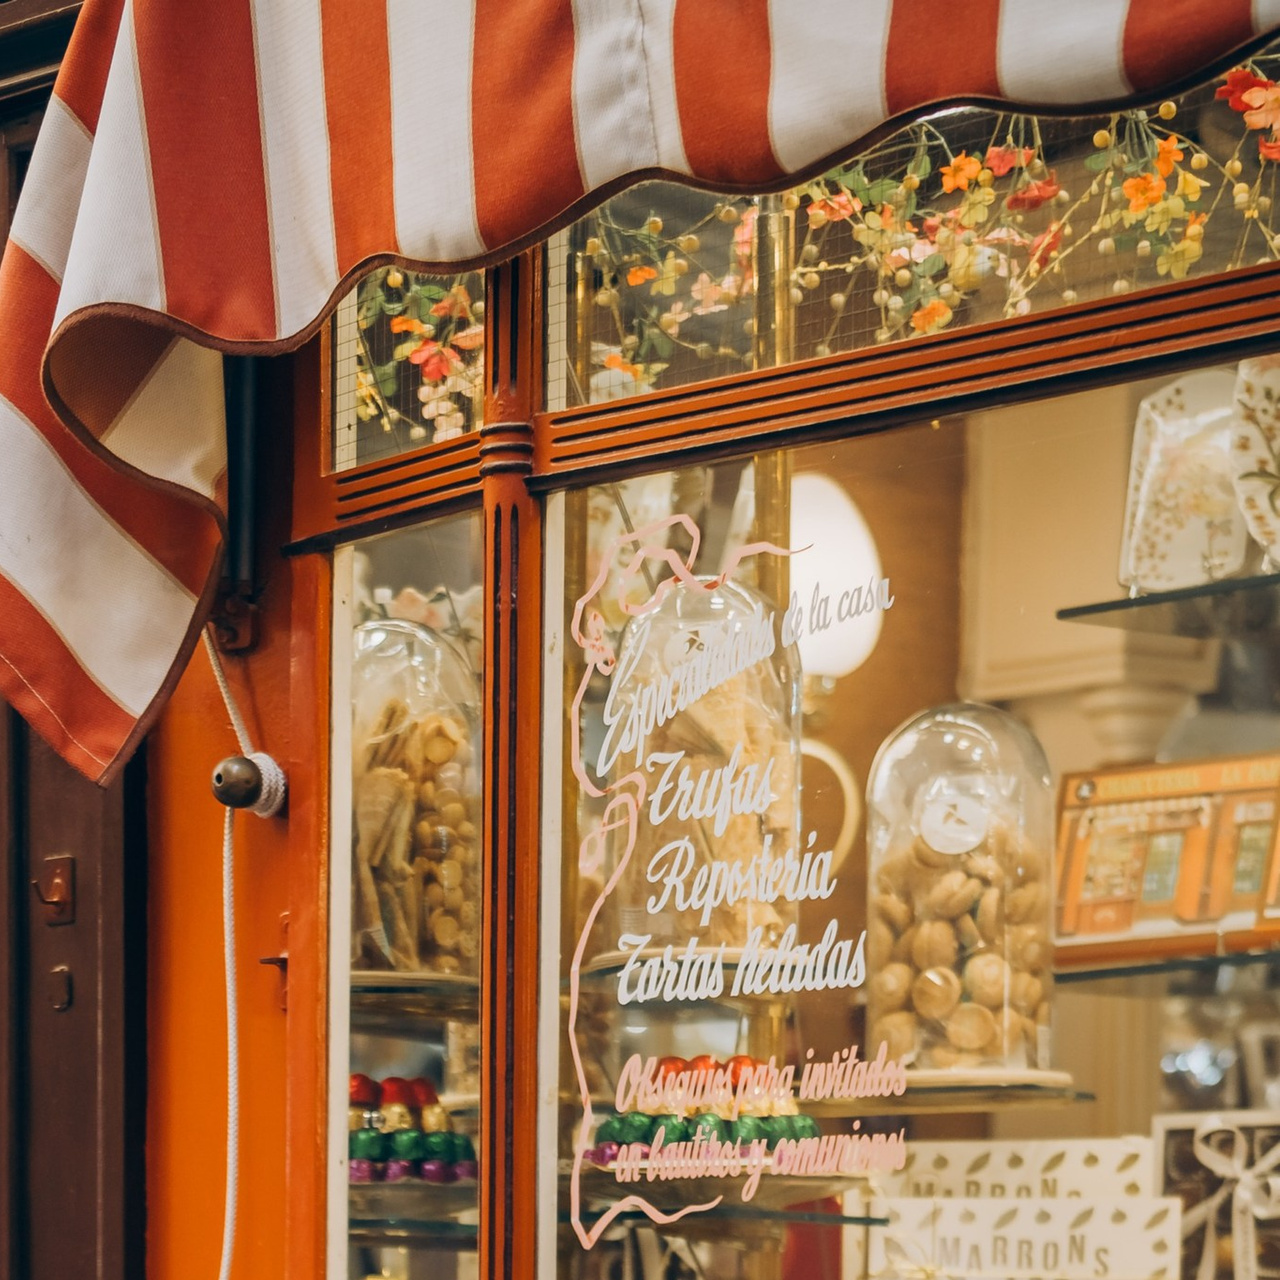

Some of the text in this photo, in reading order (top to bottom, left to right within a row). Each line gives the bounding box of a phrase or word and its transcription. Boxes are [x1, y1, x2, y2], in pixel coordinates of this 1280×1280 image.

[782, 590, 804, 647] de
[809, 582, 832, 635] la
[837, 576, 896, 625] casa
[646, 742, 776, 838] Trufas
[646, 831, 838, 927] Repostería
[617, 918, 868, 1006] Tartas heladas
[615, 1041, 907, 1122] Obsequios para invitados
[615, 1144, 642, 1184] en
[741, 1138, 768, 1202] y
[771, 1120, 907, 1176] comuniones
[939, 1234, 1109, 1278] MARRONS
